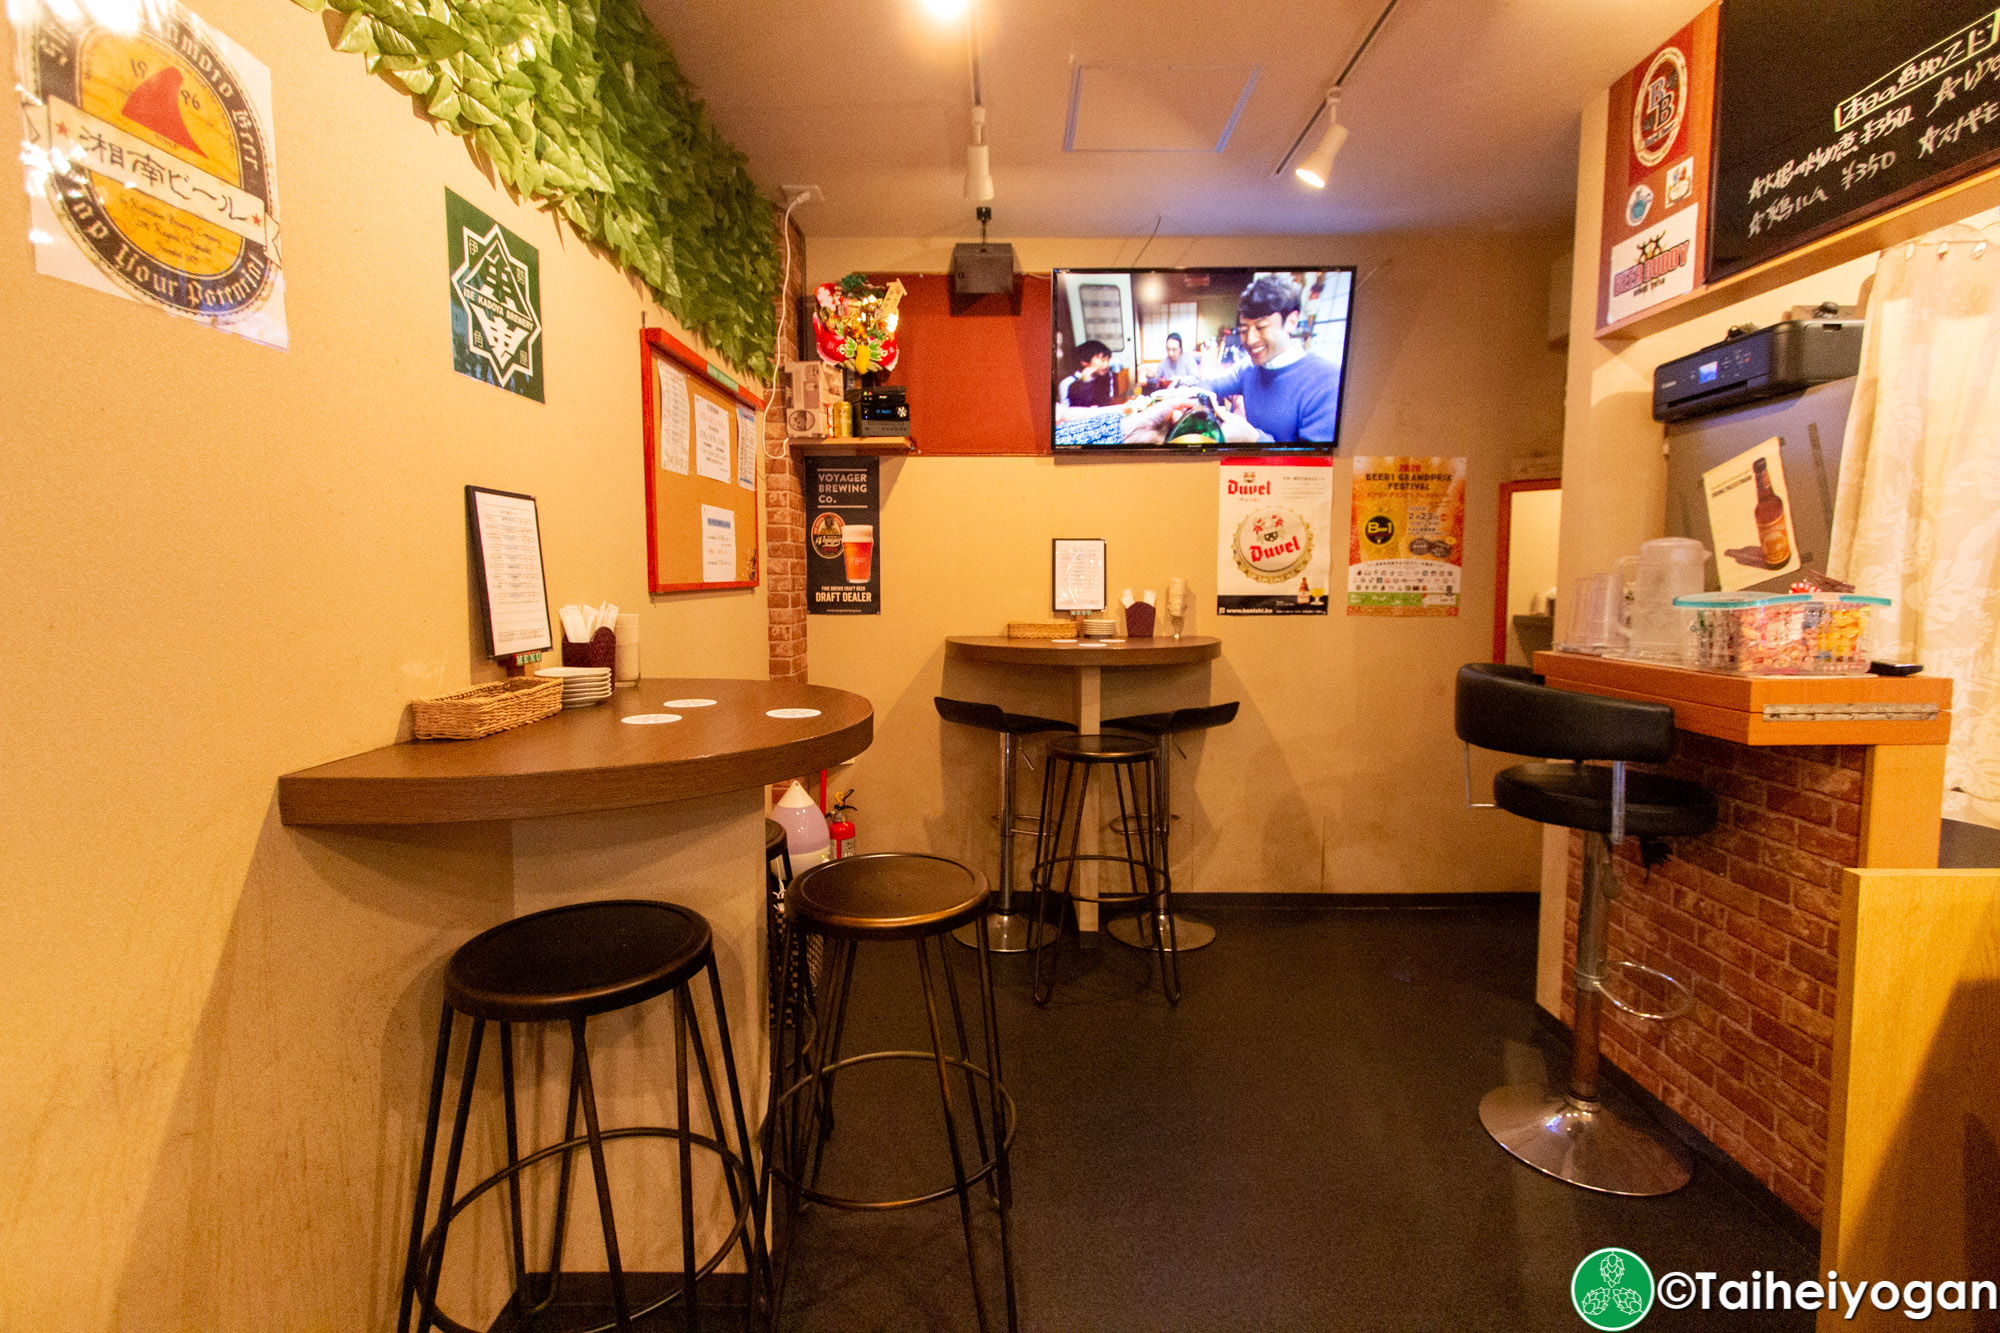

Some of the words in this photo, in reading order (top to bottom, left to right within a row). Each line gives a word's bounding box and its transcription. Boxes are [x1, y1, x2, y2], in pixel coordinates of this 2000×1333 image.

[180, 89, 201, 111] 96
[78, 125, 247, 221] 湘南ビール
[1841, 151, 1897, 191] ¥350
[1644, 240, 1690, 283] BUDDY
[463, 287, 476, 301] ISE
[478, 294, 504, 316] KADOYA
[506, 308, 534, 331] BREWERY
[818, 473, 867, 482] VOYAGER
[1398, 473, 1452, 482] GRANDPRIX
[818, 484, 867, 493] BREWING
[1227, 479, 1271, 495] Duvel
[818, 494, 837, 504] Co.
[1249, 535, 1300, 563] Duvel
[815, 592, 841, 602] DRAFT
[842, 592, 872, 602] DEALER
[516, 650, 541, 667] MENU
